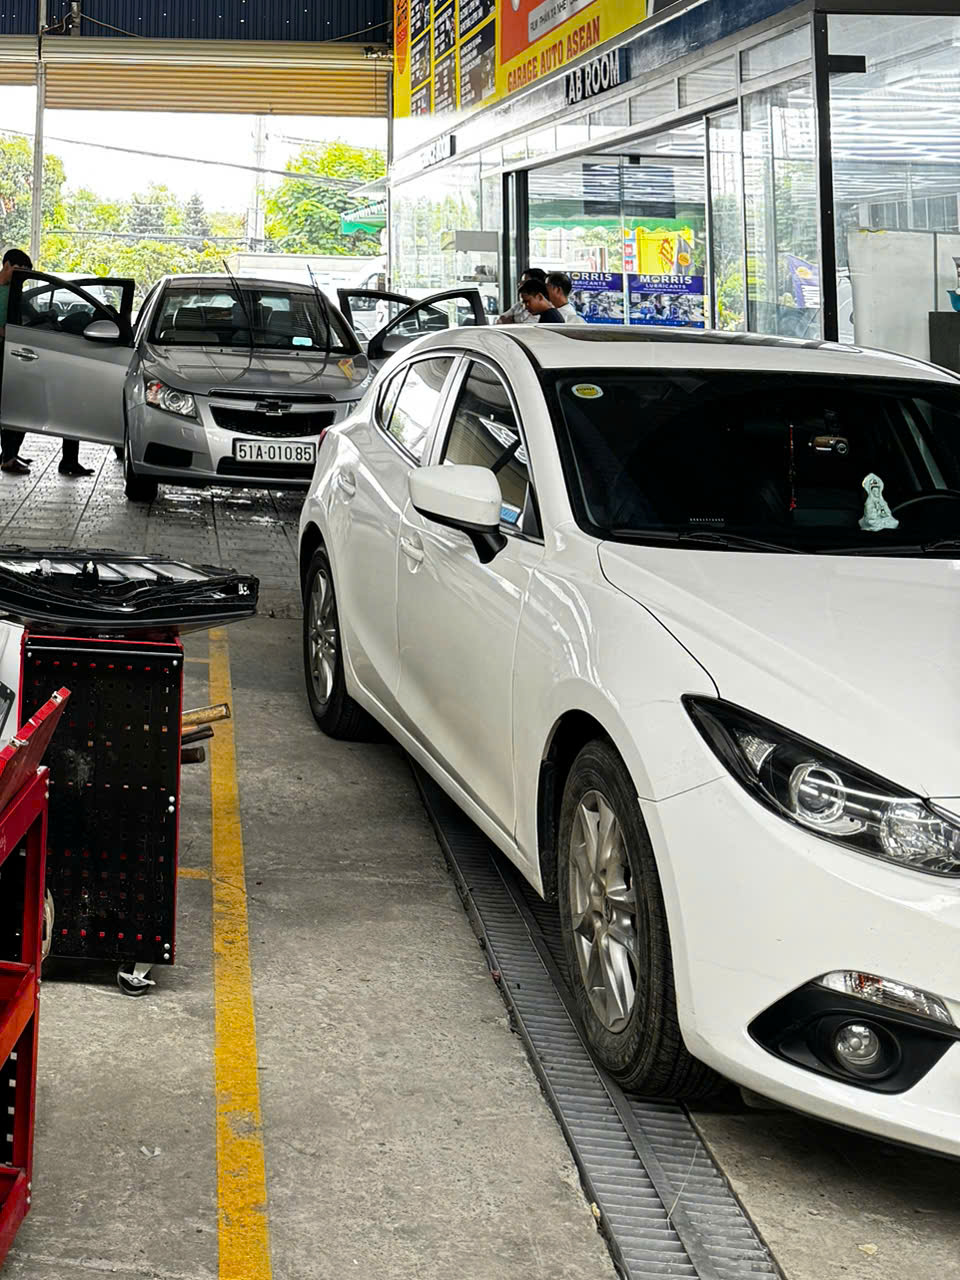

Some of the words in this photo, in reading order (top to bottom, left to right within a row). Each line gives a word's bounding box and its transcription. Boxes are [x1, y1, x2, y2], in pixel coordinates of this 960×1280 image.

[507, 55, 538, 92] GARAGE
[539, 40, 564, 74] AUTO
[566, 16, 601, 61] ASEAN
[585, 47, 620, 97] ROOM
[640, 275, 693, 284] MORRIS
[239, 444, 312, 462] 51A-010.85
